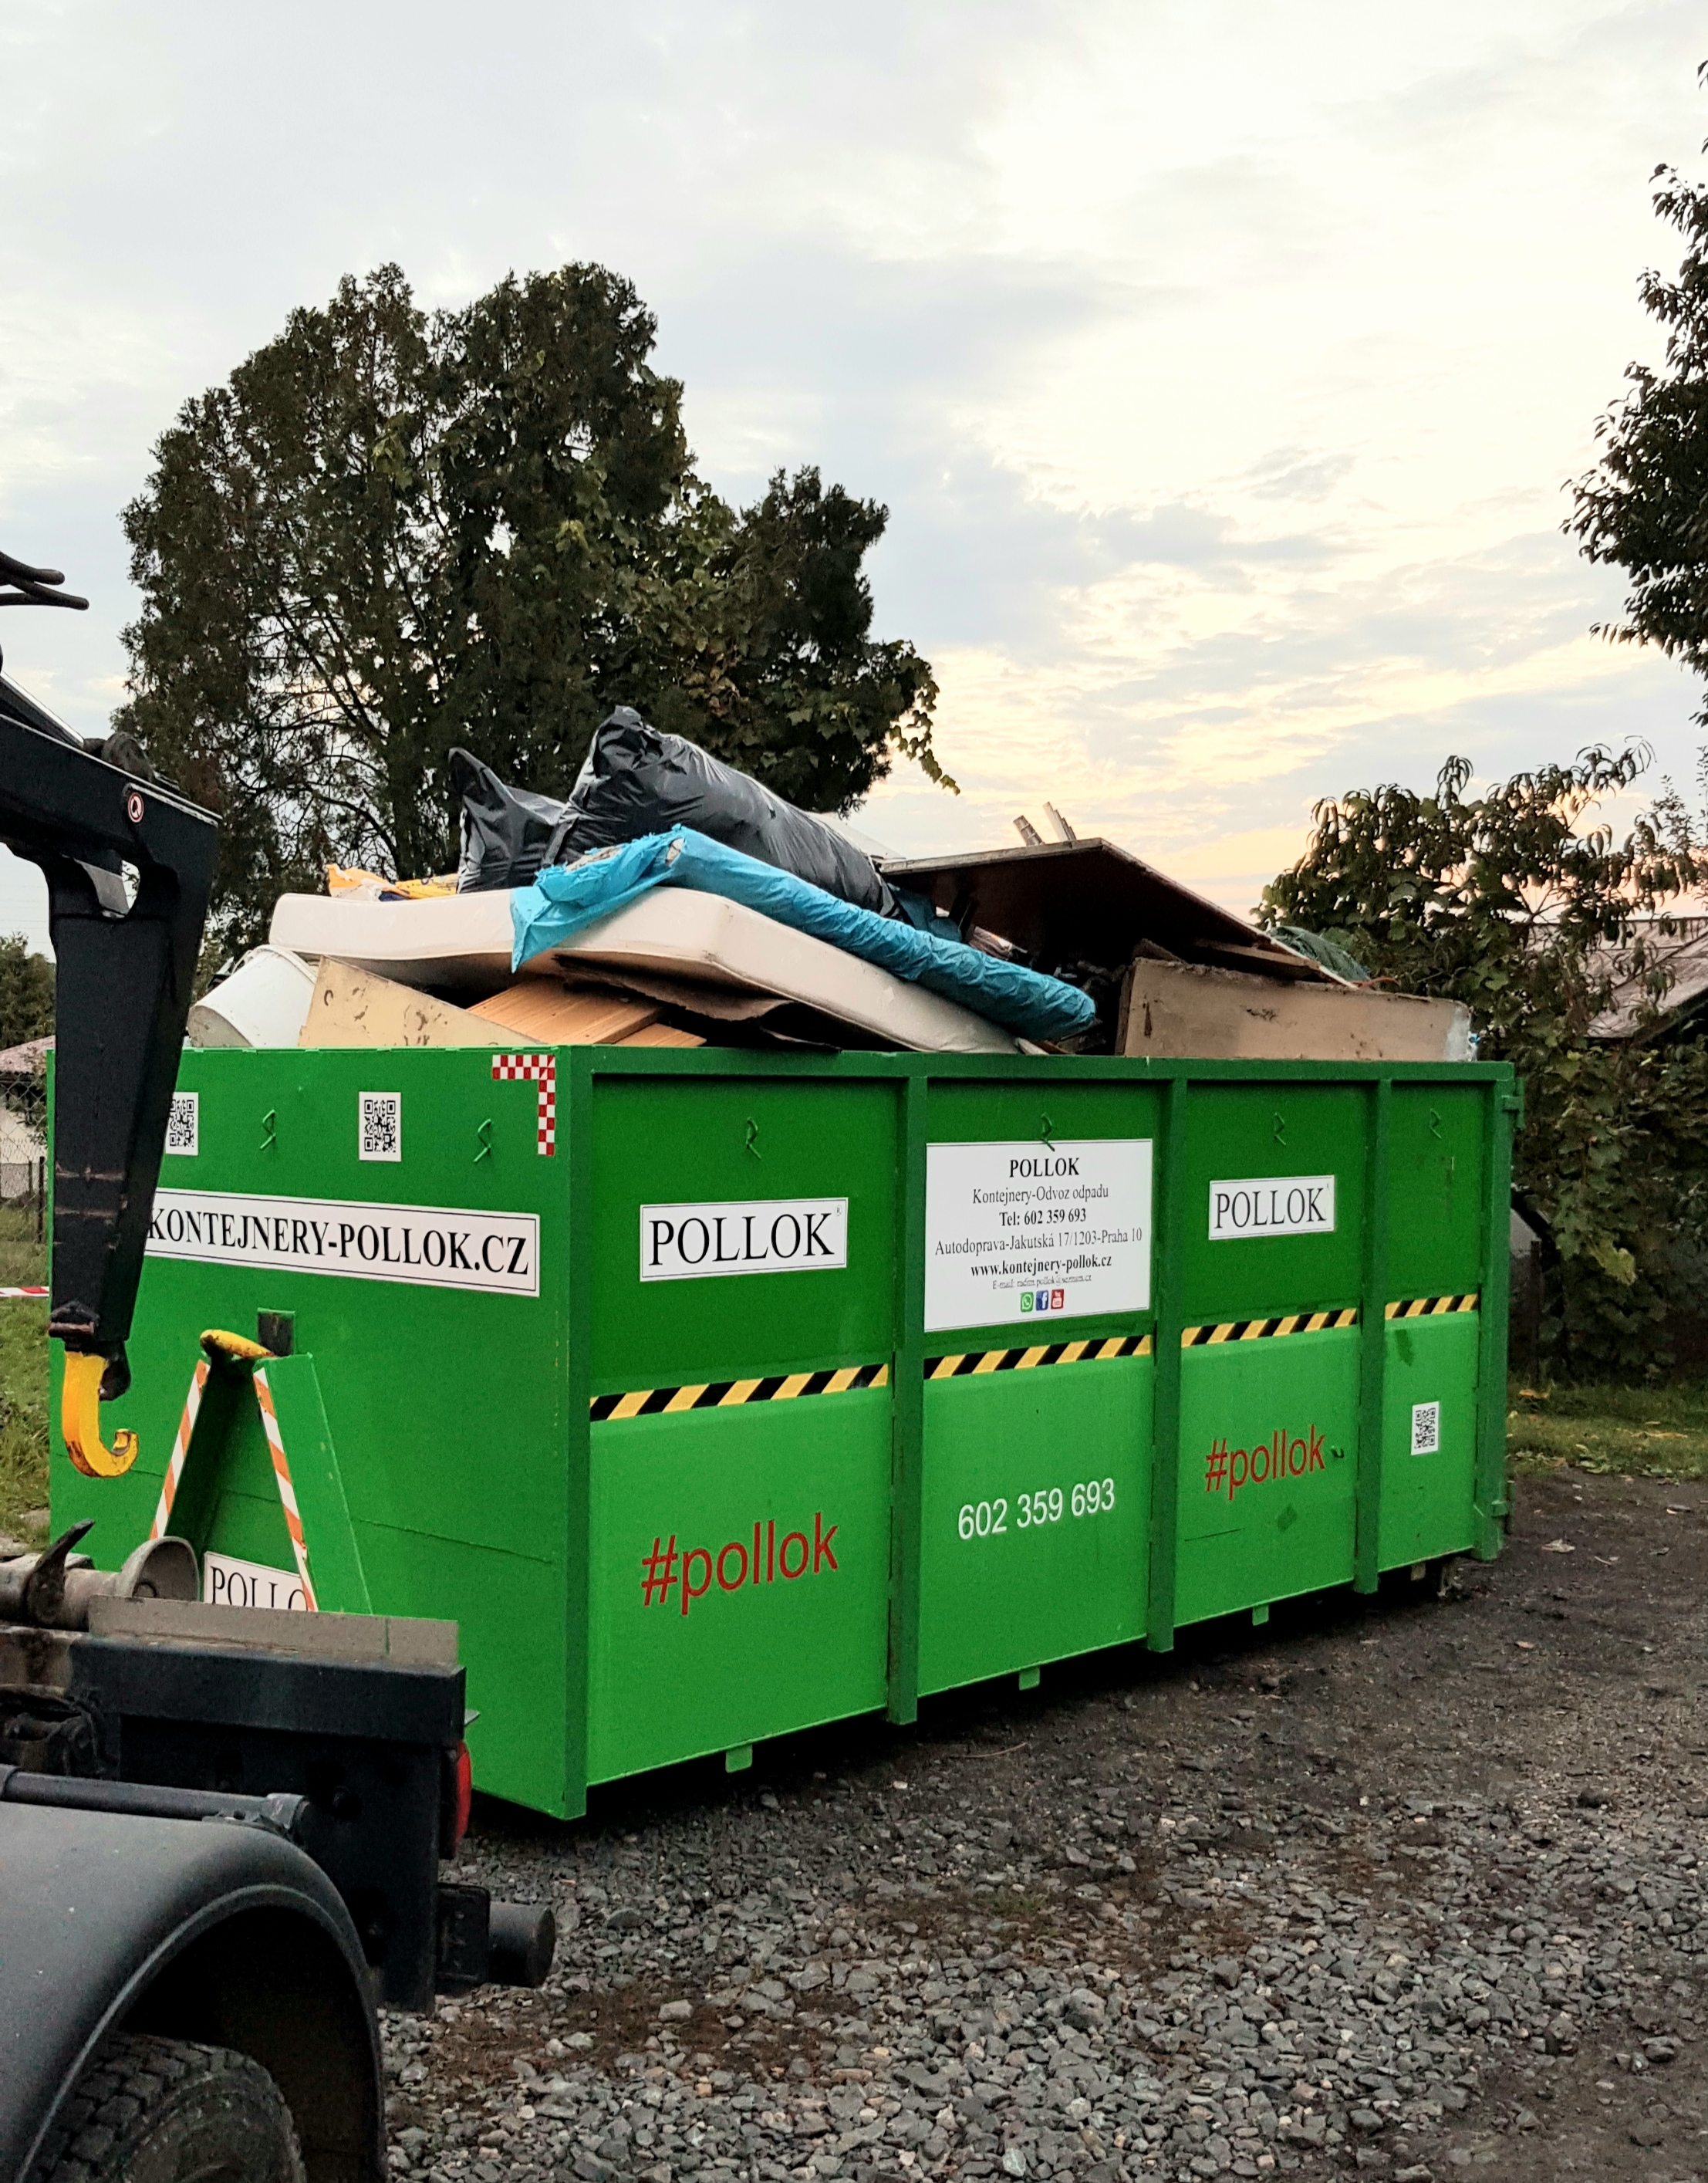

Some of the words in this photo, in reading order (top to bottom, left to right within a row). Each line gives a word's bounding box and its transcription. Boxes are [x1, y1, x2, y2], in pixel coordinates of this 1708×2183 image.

[1009, 1157, 1080, 1178] POLLOK
[972, 1185, 1070, 1206] Kontejnery-Odvoz
[1072, 1183, 1109, 1204] odpadu
[1213, 1187, 1326, 1229] POLLOK
[998, 1211, 1021, 1227] Tel:
[1024, 1210, 1044, 1225] 602
[1046, 1208, 1065, 1224] 359
[1068, 1208, 1087, 1222] 693
[147, 1208, 529, 1276] KONTEJNERY-POLLOK.CZ
[648, 1212, 835, 1266] POLLOK
[934, 1233, 1055, 1256] Autodoprava-Jakutská
[1058, 1228, 1129, 1248] 17/1203-Praha
[1131, 1227, 1143, 1242] 10
[970, 1255, 1112, 1276] www.kontejnery-pollok.cz
[1205, 1423, 1325, 1501] #pollok
[958, 1497, 1008, 1540] 602
[1016, 1487, 1064, 1529] 359
[1071, 1477, 1116, 1517] 693
[641, 1512, 839, 1616] #pollok
